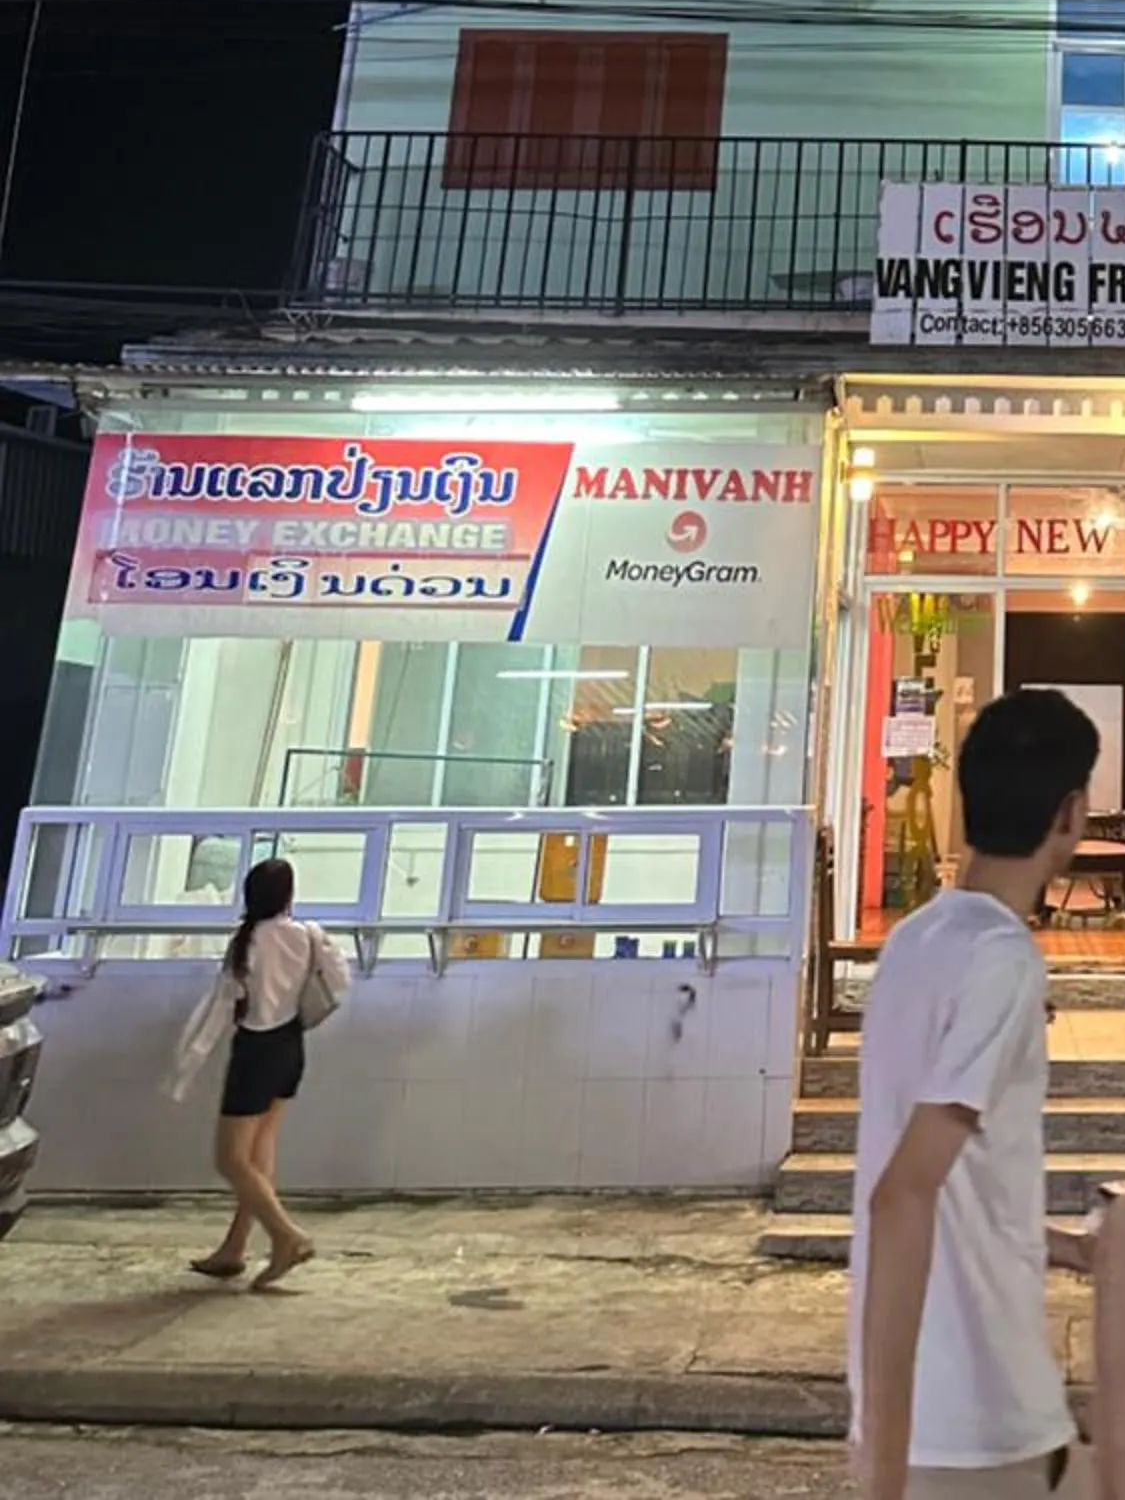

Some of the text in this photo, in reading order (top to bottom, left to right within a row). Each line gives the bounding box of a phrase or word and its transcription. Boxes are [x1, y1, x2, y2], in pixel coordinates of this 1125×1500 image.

[573, 467, 813, 503] MANIVANH
[106, 517, 508, 549] MONEY EXCHANGE
[870, 518, 996, 553] HAPPY
[1016, 518, 1111, 553] NEW
[605, 560, 759, 587] MoneyGram
